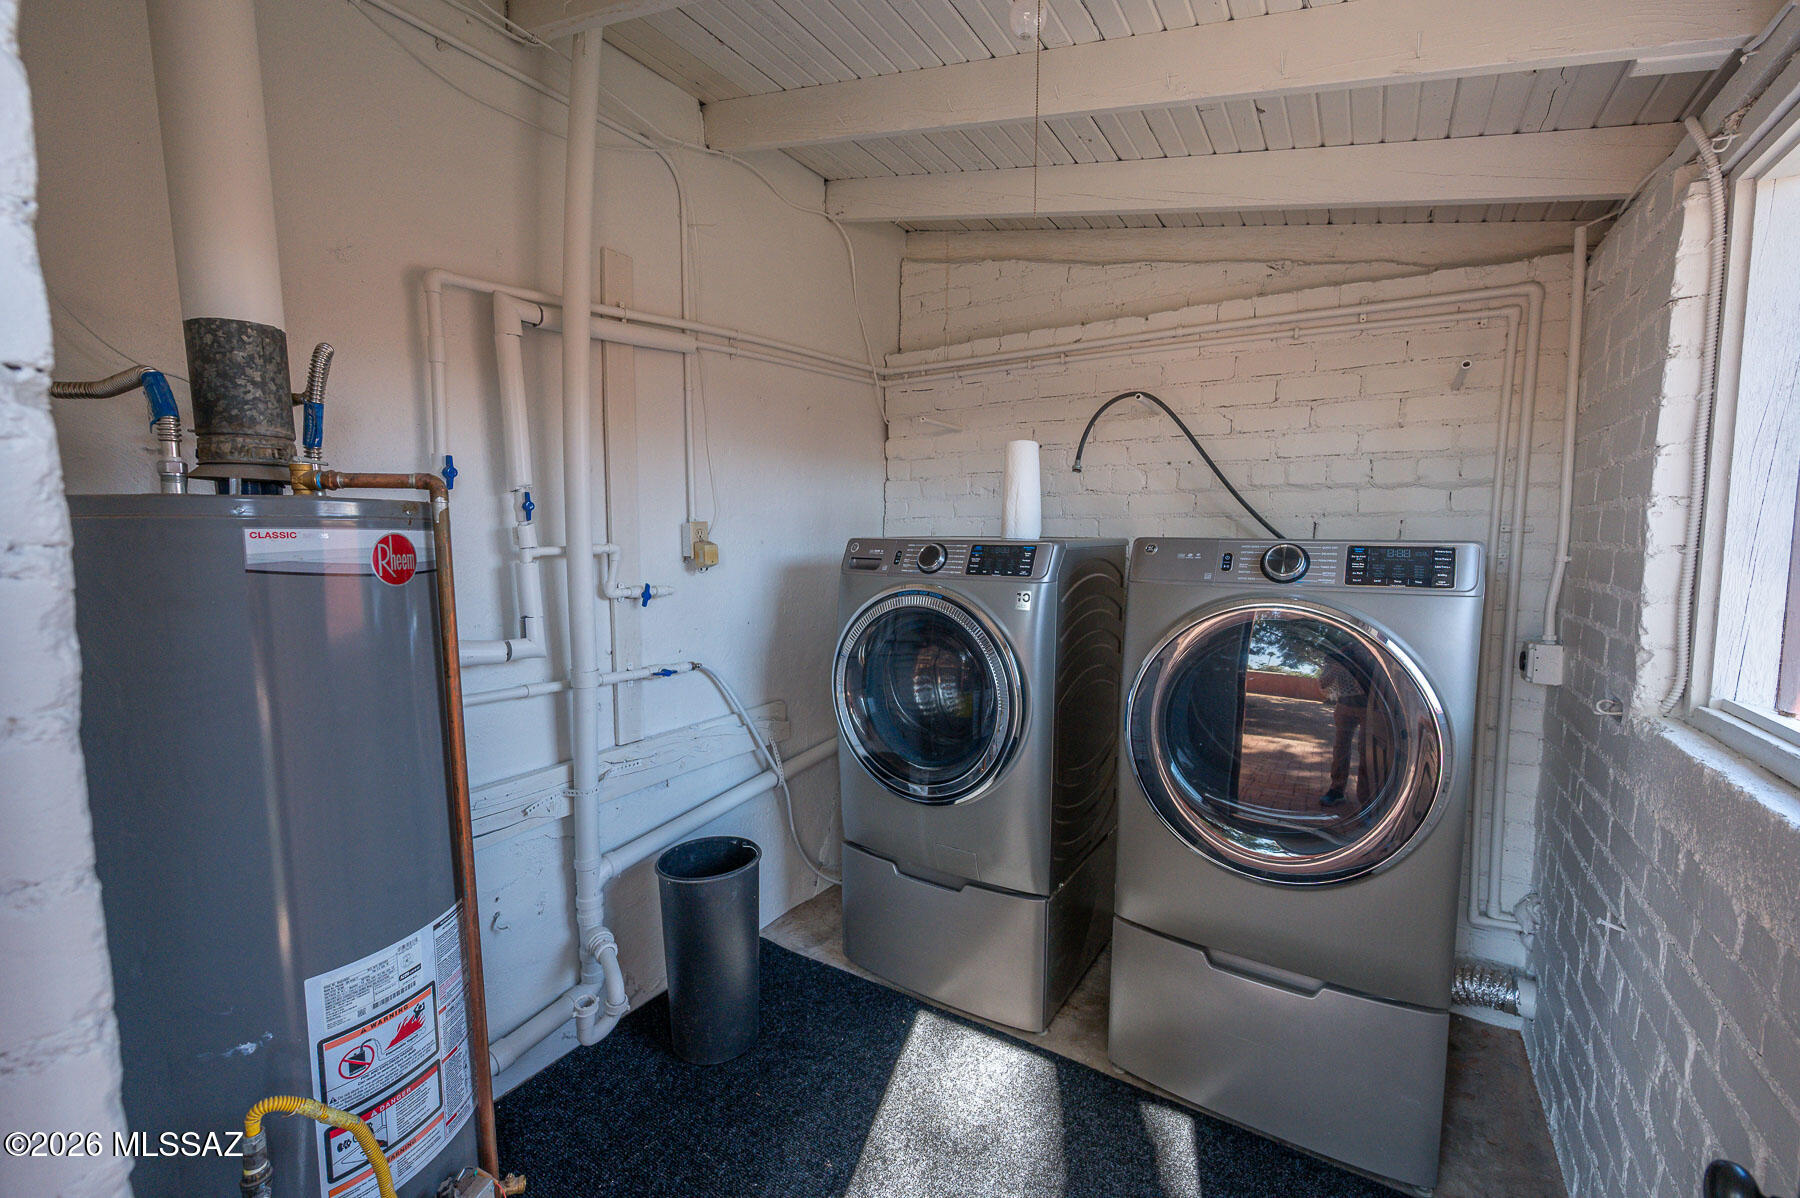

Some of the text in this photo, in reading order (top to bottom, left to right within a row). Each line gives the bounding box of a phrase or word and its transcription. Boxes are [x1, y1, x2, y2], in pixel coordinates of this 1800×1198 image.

[249, 531, 297, 539] CLASSIC
[377, 535, 416, 578] Rheem
[370, 1004, 409, 1028] WARNING
[379, 1087, 412, 1111] DANGER
